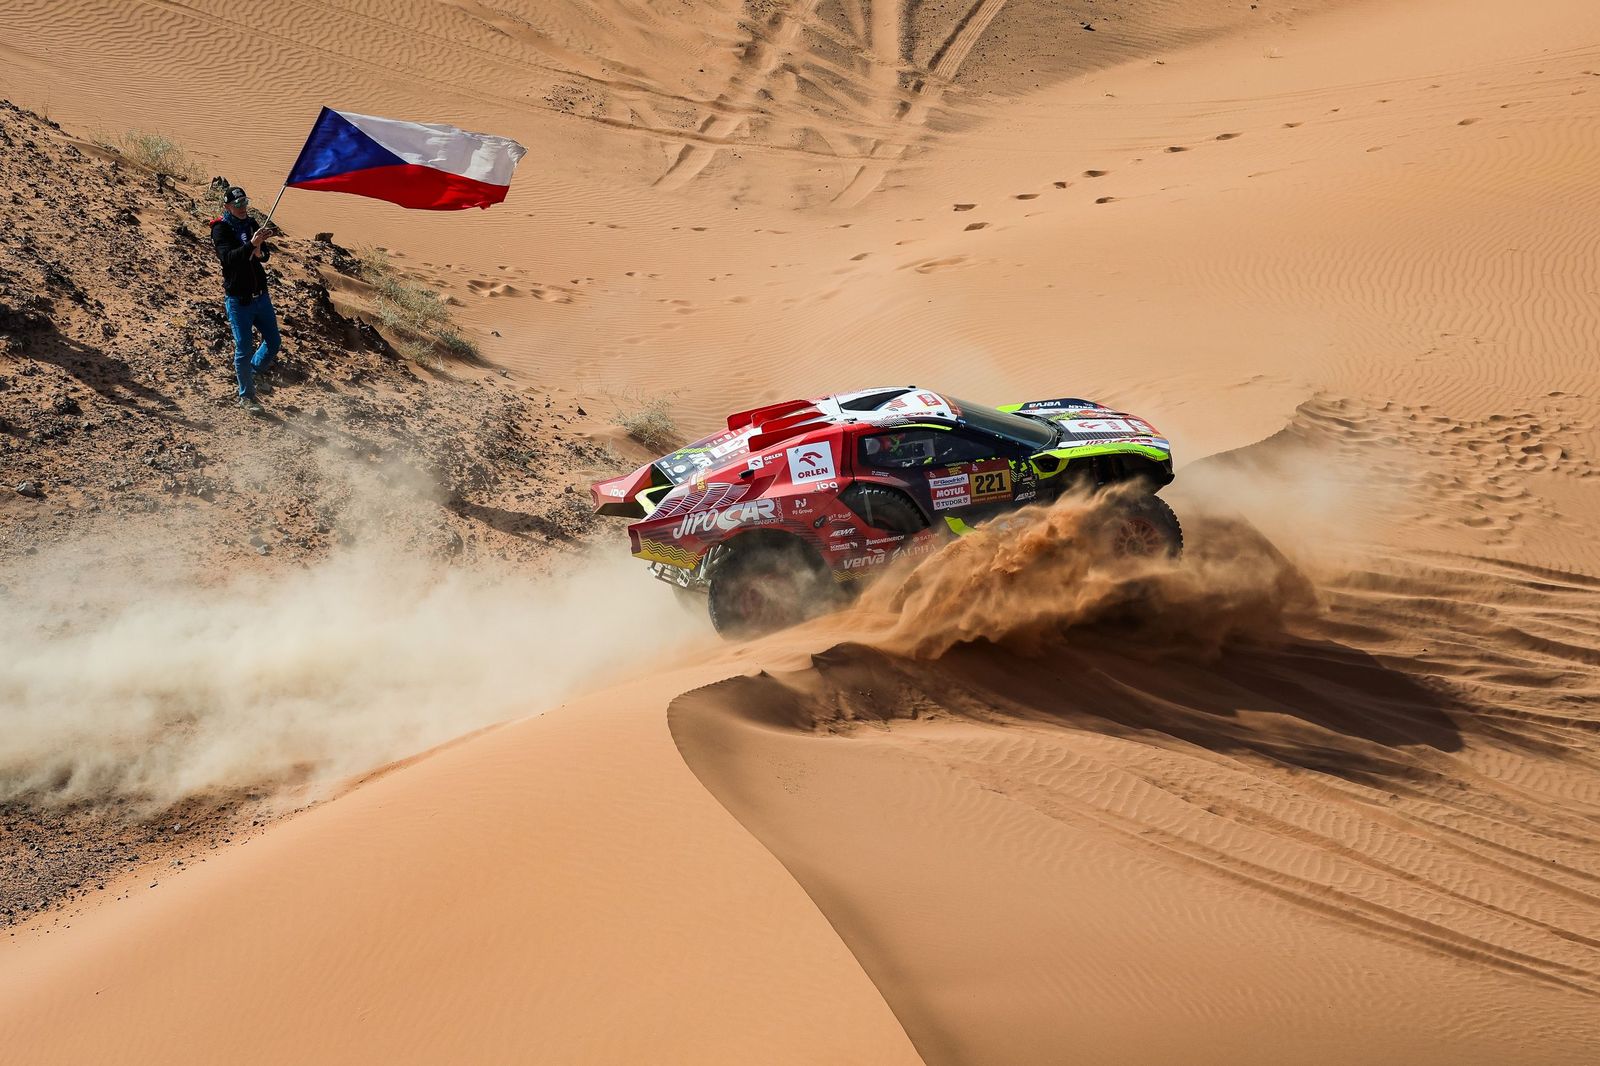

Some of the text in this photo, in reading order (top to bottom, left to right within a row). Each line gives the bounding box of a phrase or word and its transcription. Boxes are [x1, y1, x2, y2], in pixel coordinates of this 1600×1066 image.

[763, 452, 783, 461] ORLEN
[797, 467, 829, 479] ORLEN
[974, 472, 1007, 495] 221
[936, 486, 966, 498] MOTUL
[940, 498, 963, 507] TUDOR
[672, 498, 777, 539] JIPOCAR
[843, 553, 886, 569] verva
